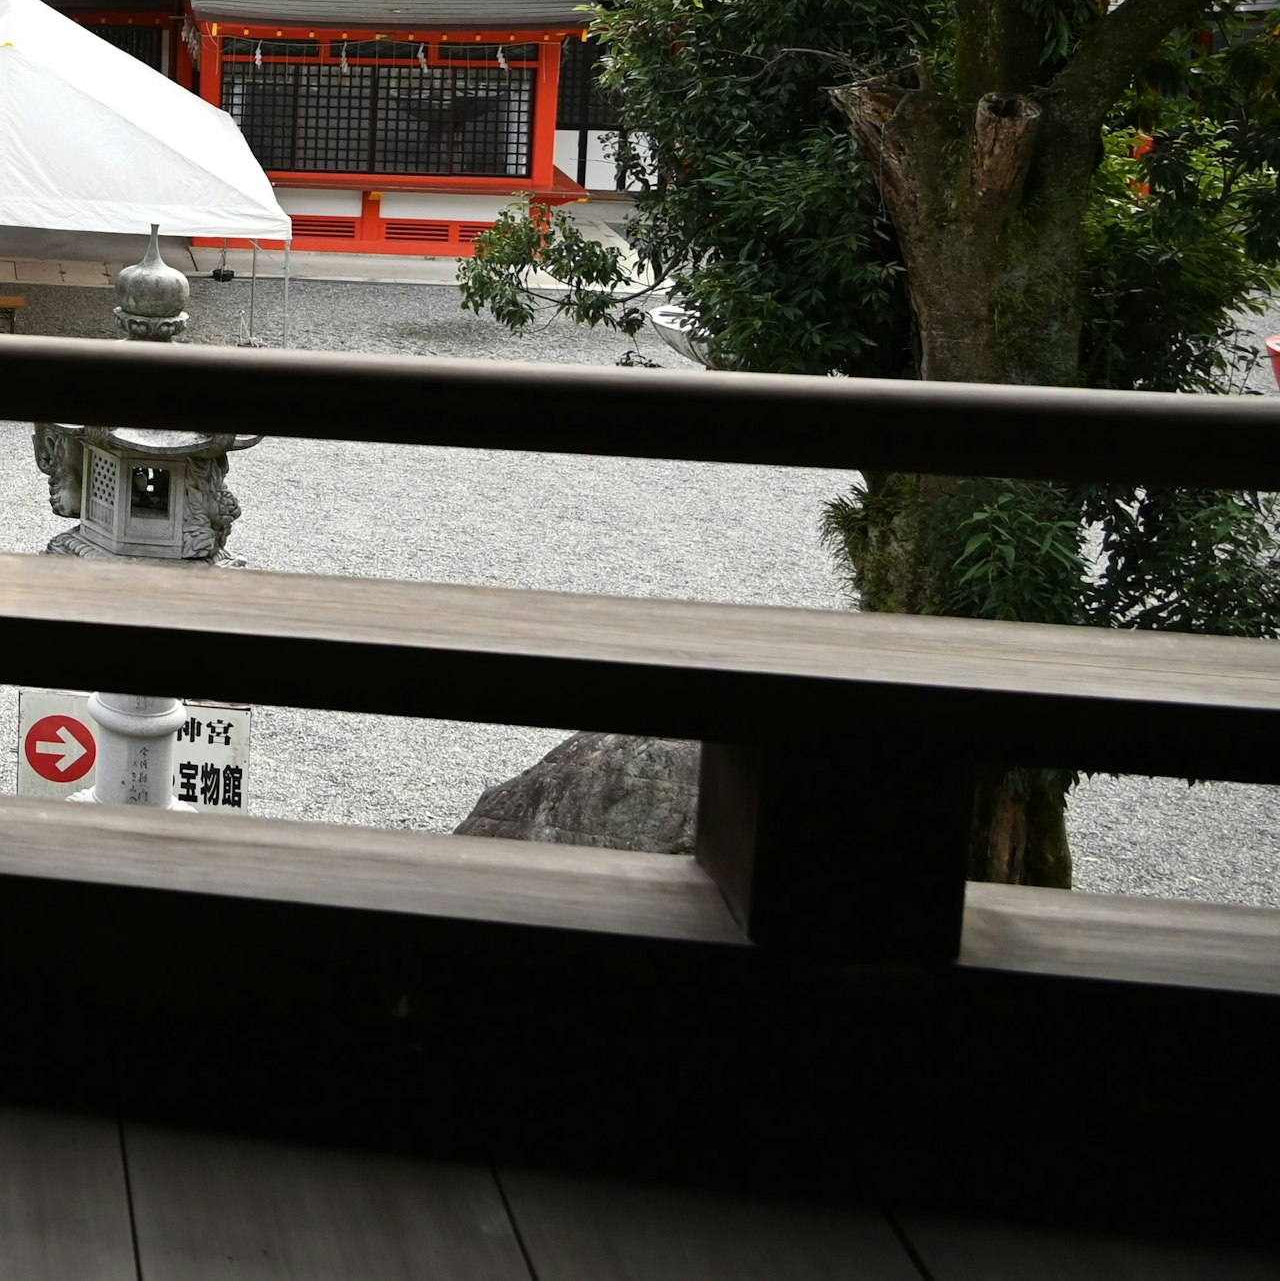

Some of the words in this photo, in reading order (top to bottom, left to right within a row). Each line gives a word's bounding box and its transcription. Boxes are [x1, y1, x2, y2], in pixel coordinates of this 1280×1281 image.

[177, 717, 234, 745] 神宮
[173, 761, 242, 808] 宝物館
